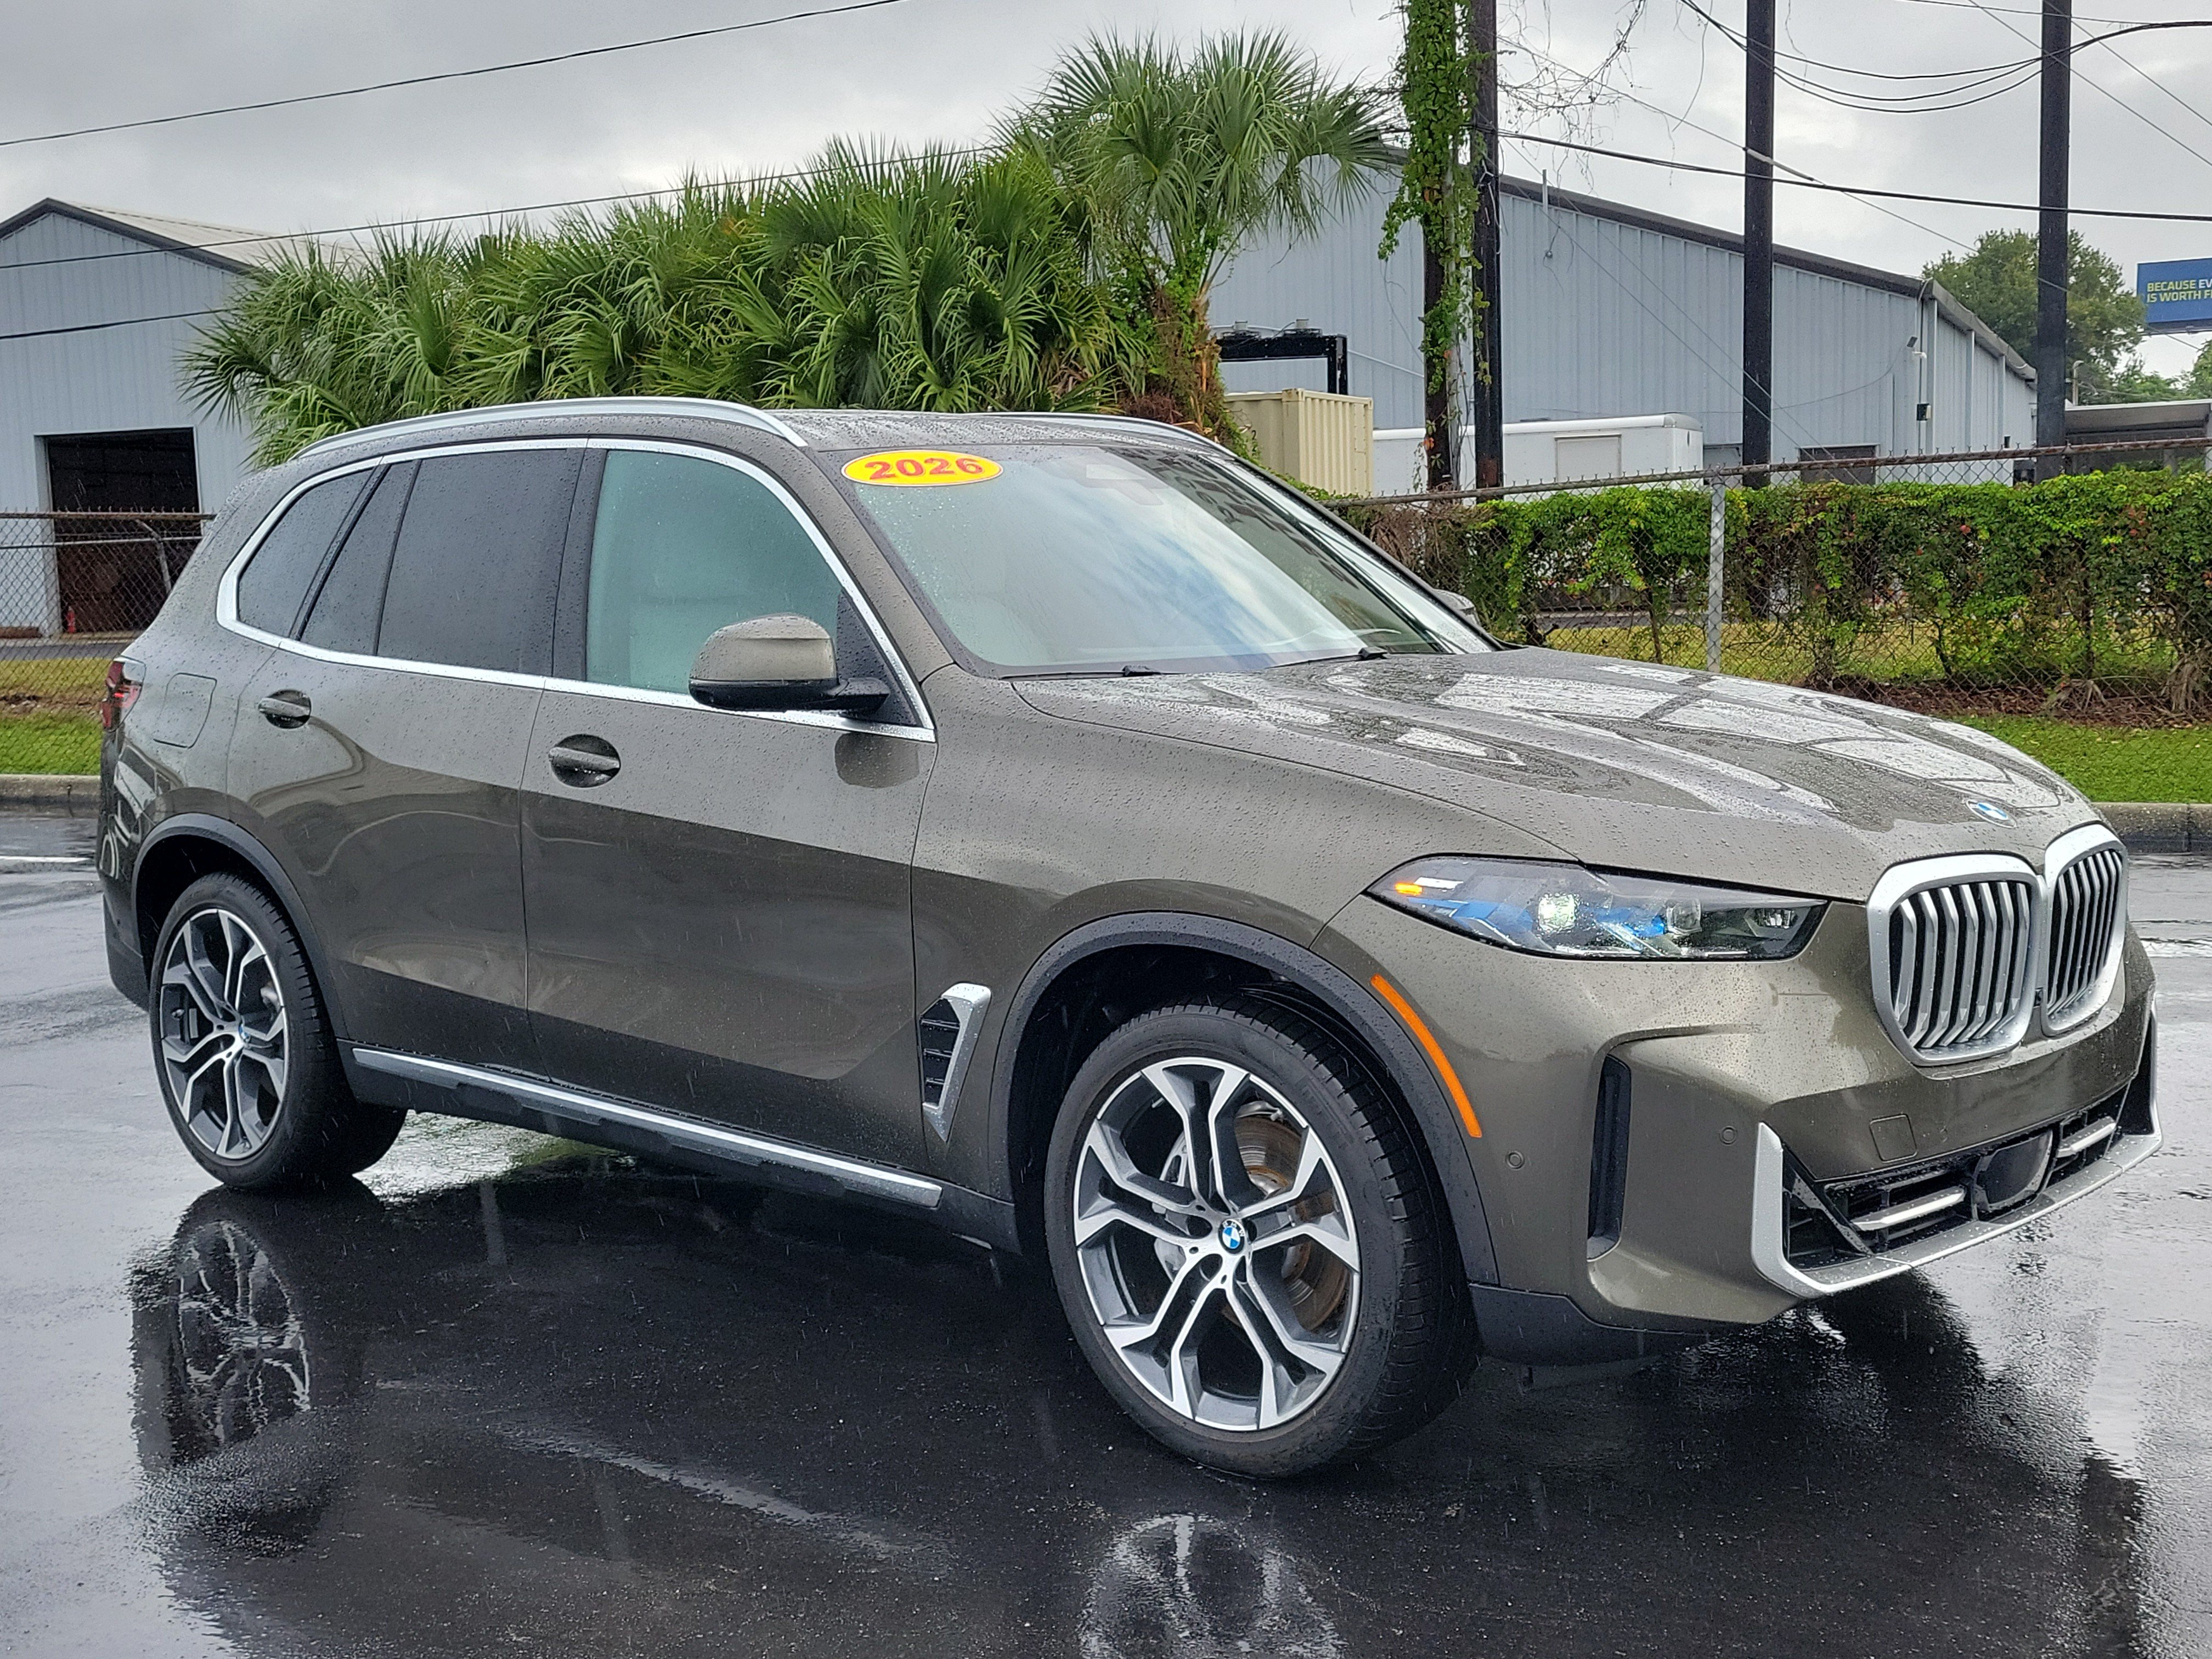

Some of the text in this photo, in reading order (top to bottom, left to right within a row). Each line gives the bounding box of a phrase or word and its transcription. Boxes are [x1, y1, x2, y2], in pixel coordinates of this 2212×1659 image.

[2147, 280, 2196, 292] BECAUSE
[2147, 293, 2157, 303] IS
[2159, 290, 2201, 302] WORTH
[865, 458, 984, 480] 2026
